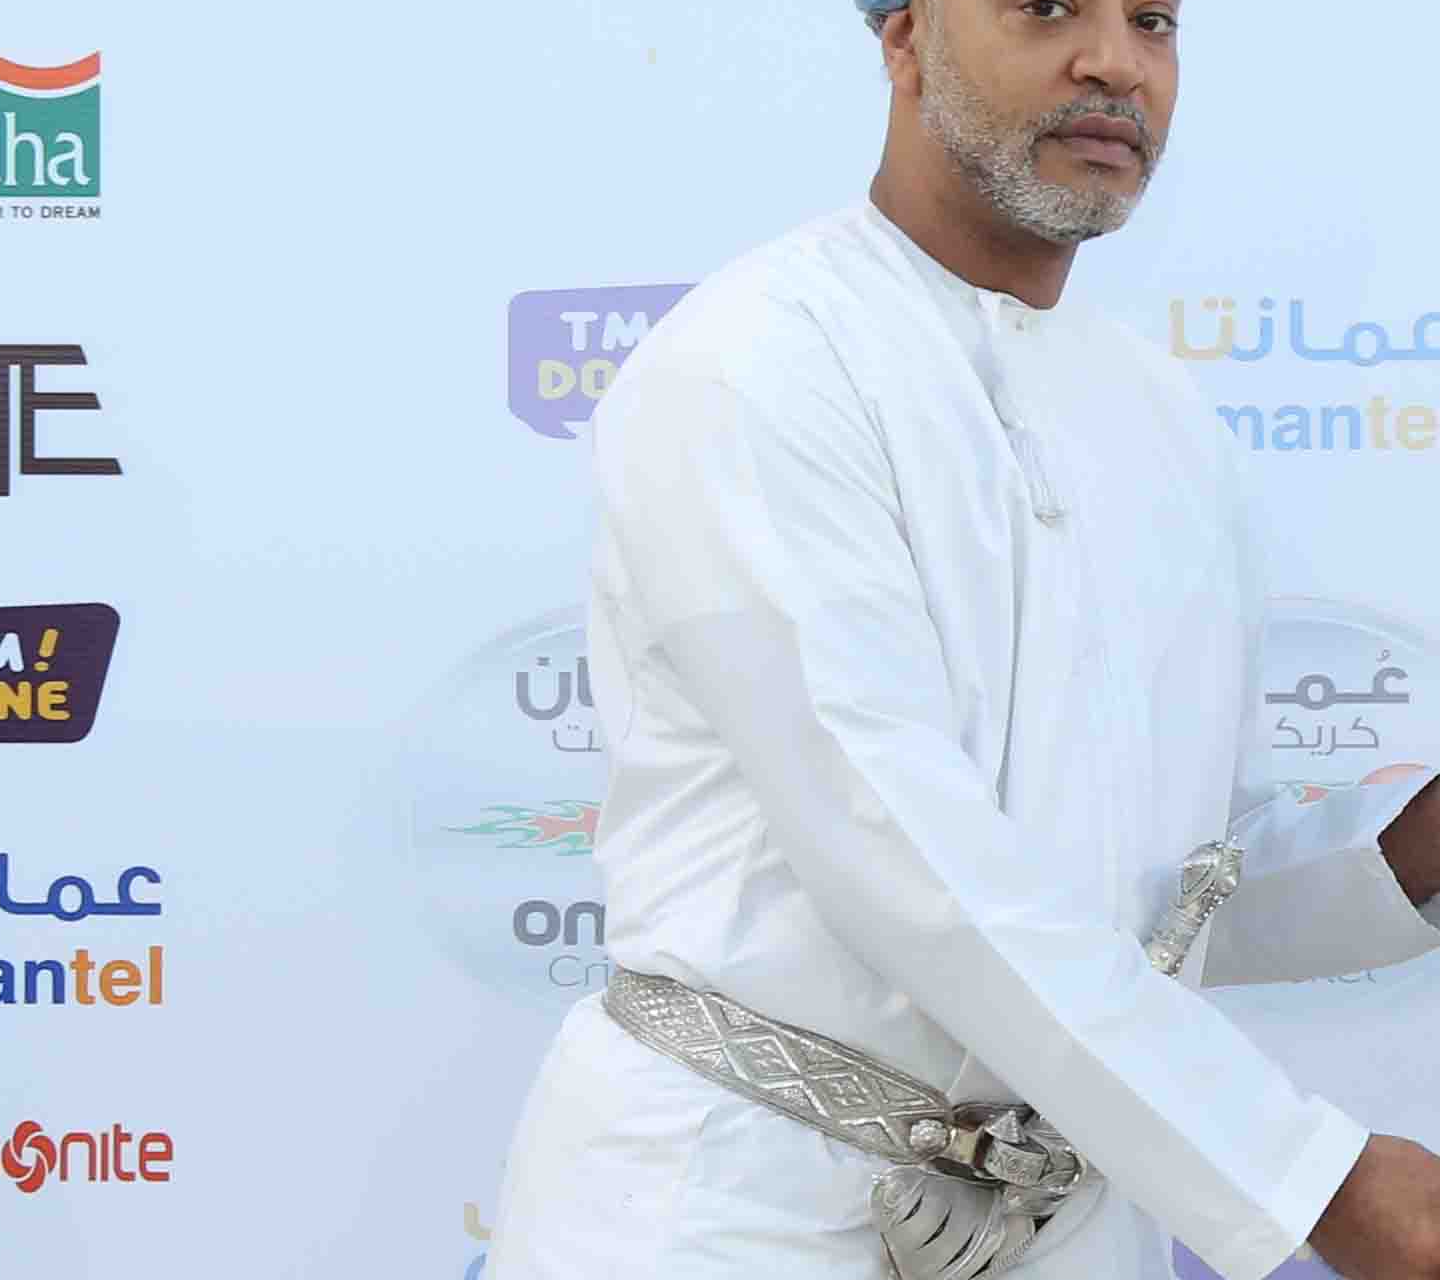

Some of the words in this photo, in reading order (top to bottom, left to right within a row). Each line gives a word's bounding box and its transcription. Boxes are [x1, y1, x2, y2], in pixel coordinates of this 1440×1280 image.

[11, 206, 34, 219] TO
[40, 206, 101, 219] DREAM
[560, 311, 652, 352] TM
[536, 358, 617, 400] DO
[1271, 715, 1379, 756] كريك
